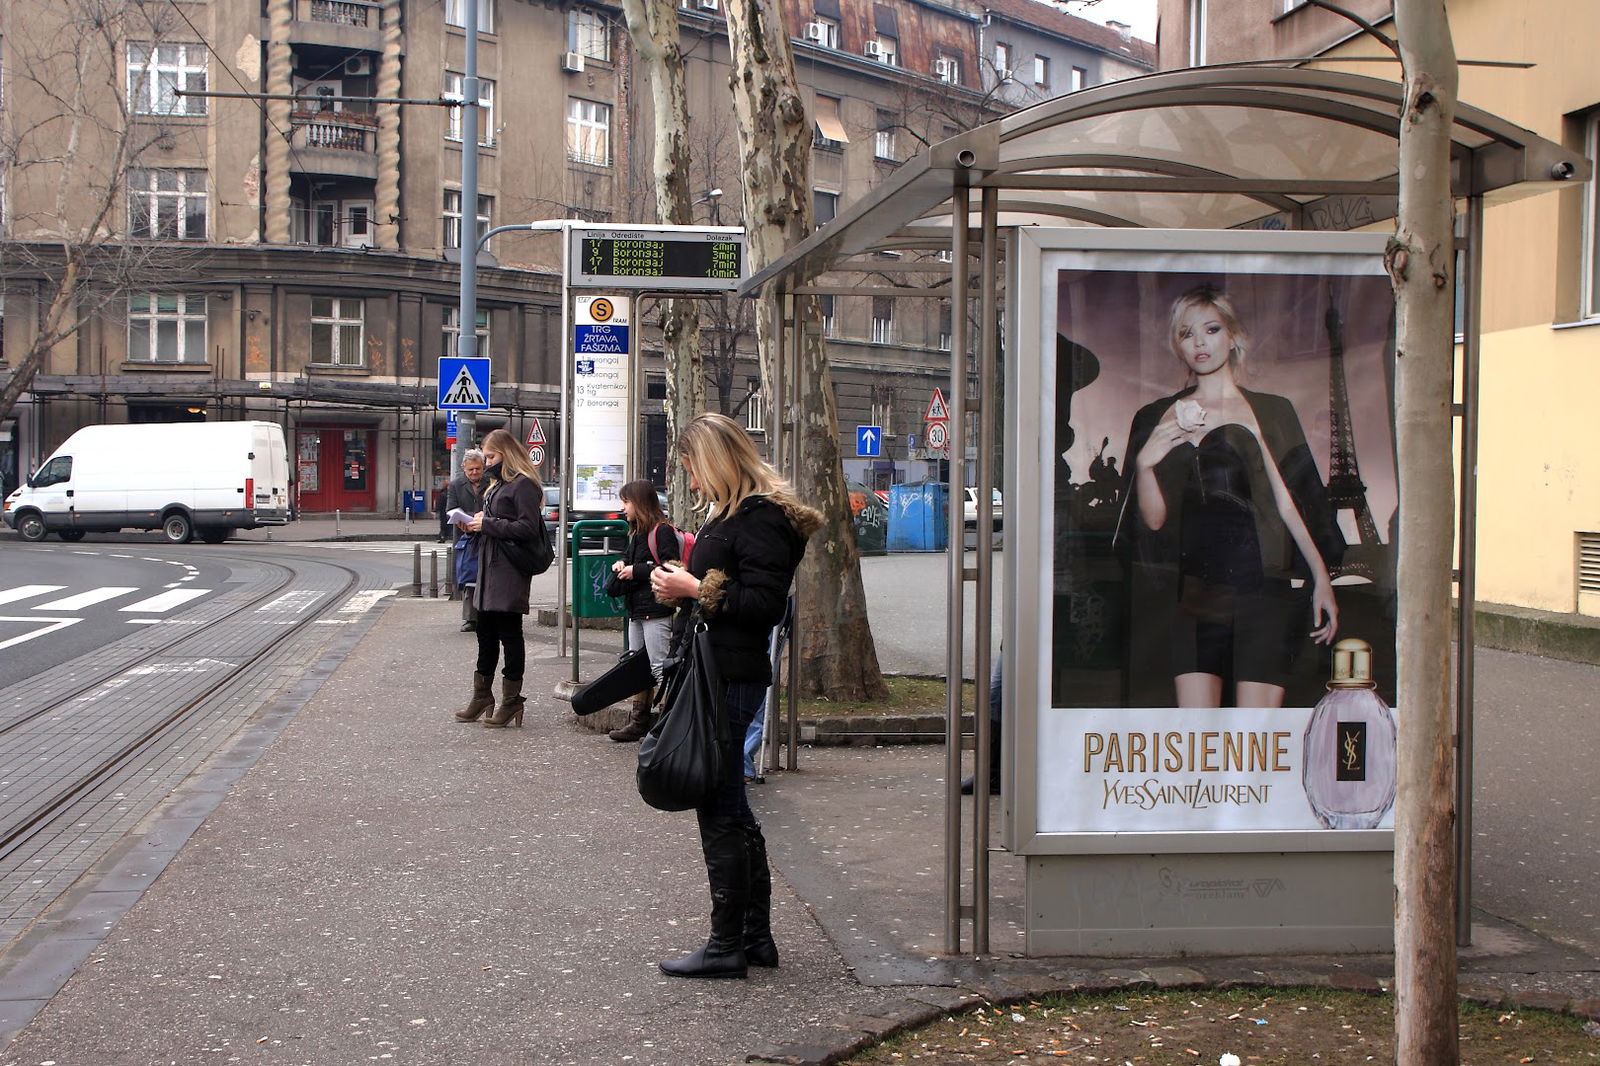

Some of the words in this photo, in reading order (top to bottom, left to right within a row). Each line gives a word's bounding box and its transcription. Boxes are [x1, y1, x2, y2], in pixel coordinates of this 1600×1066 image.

[587, 231, 606, 239] Linija
[613, 240, 664, 249] Borongaj
[592, 247, 599, 256] 9
[613, 248, 664, 258] Borongaj
[712, 250, 737, 260] 3min
[589, 256, 603, 266] 17
[613, 257, 664, 267] Borongaj
[591, 266, 598, 275] 1
[613, 266, 664, 276] Borongaj
[596, 303, 607, 317] S
[592, 325, 611, 334] TRG
[583, 333, 619, 343] ŽRTAVA
[581, 343, 622, 352] FAŠIZMA
[577, 385, 585, 394] 13
[577, 398, 585, 407] 17
[587, 399, 619, 407] Borongaj
[931, 429, 943, 443] 30
[531, 450, 541, 462] 30
[1083, 731, 1292, 773] PARISIENNE
